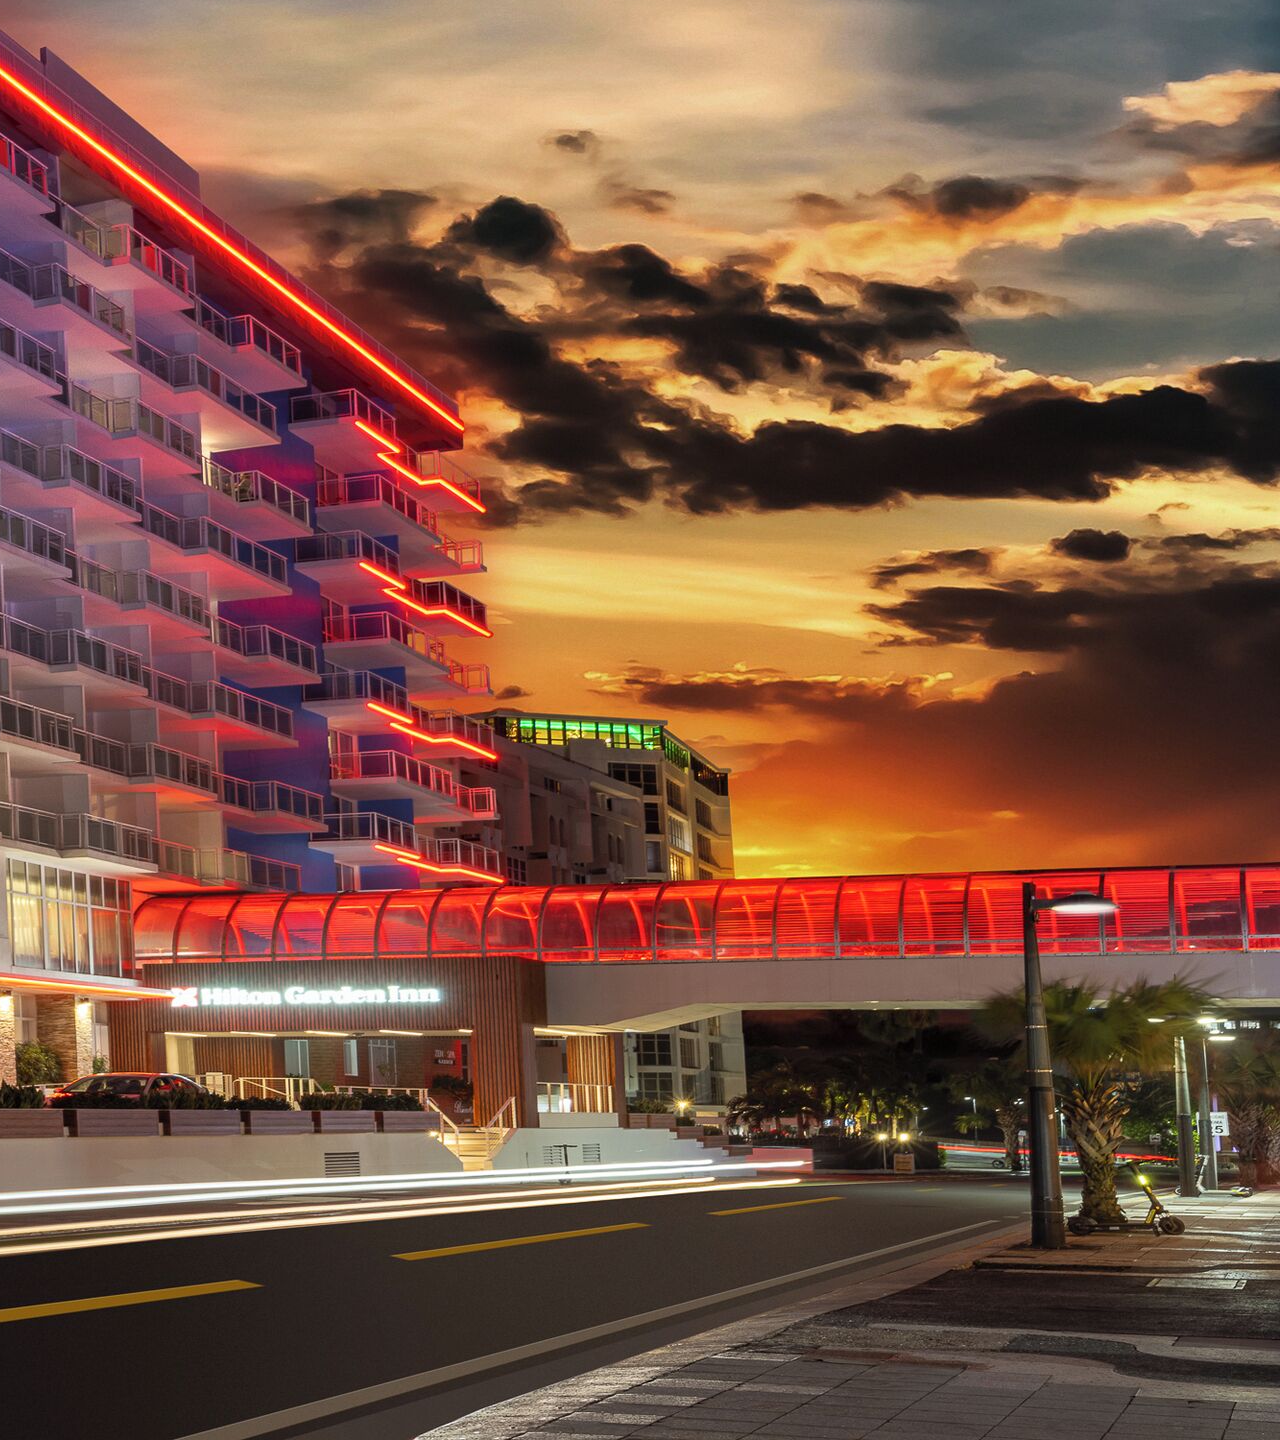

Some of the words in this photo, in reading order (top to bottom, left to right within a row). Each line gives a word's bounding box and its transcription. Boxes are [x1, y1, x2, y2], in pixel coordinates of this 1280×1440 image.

[200, 987, 281, 1006] Hilton
[284, 986, 387, 1005] Garden
[387, 985, 440, 1003] Inn
